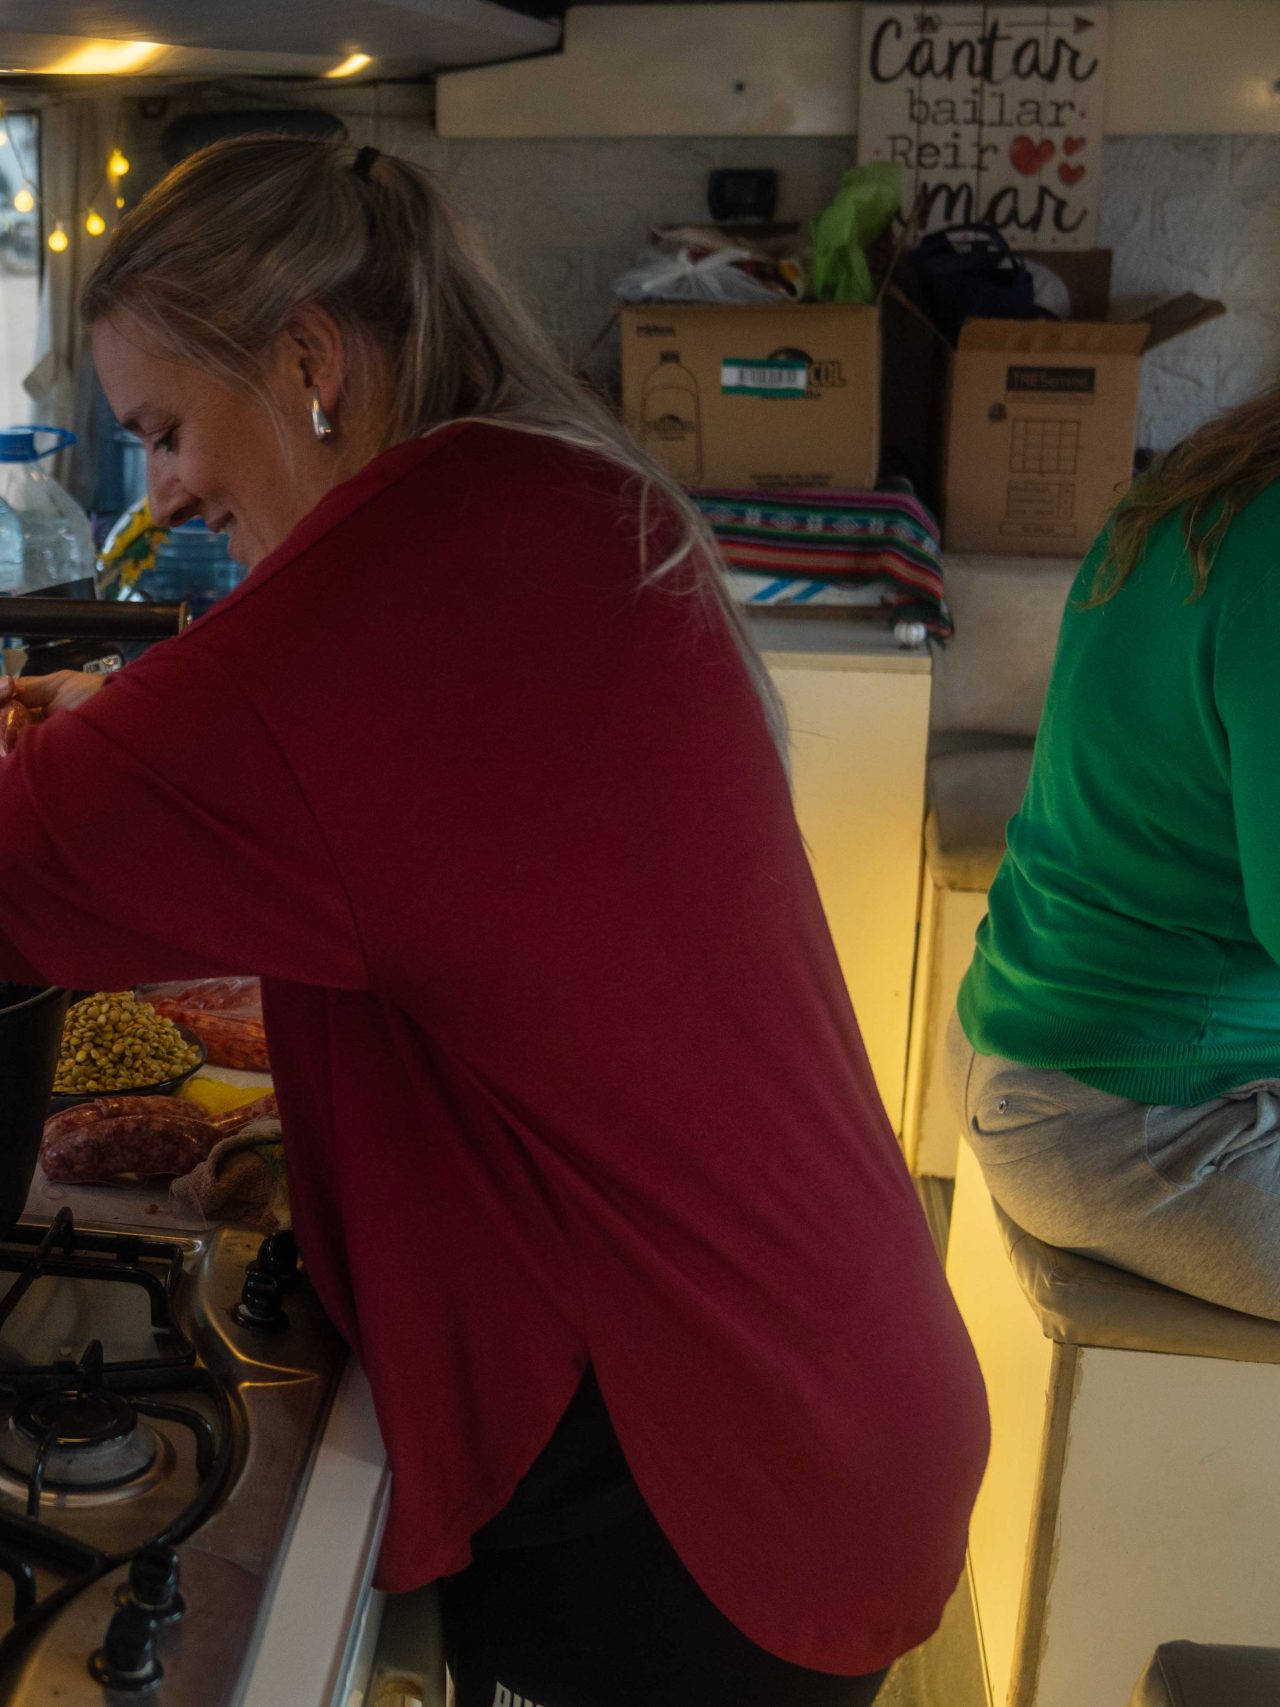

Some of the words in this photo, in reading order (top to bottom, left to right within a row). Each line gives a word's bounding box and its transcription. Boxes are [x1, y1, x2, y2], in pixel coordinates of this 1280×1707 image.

[869, 17, 1099, 85] Cantar
[906, 88, 1076, 128] bailar
[888, 132, 999, 172] Reir
[893, 181, 1088, 234] mar
